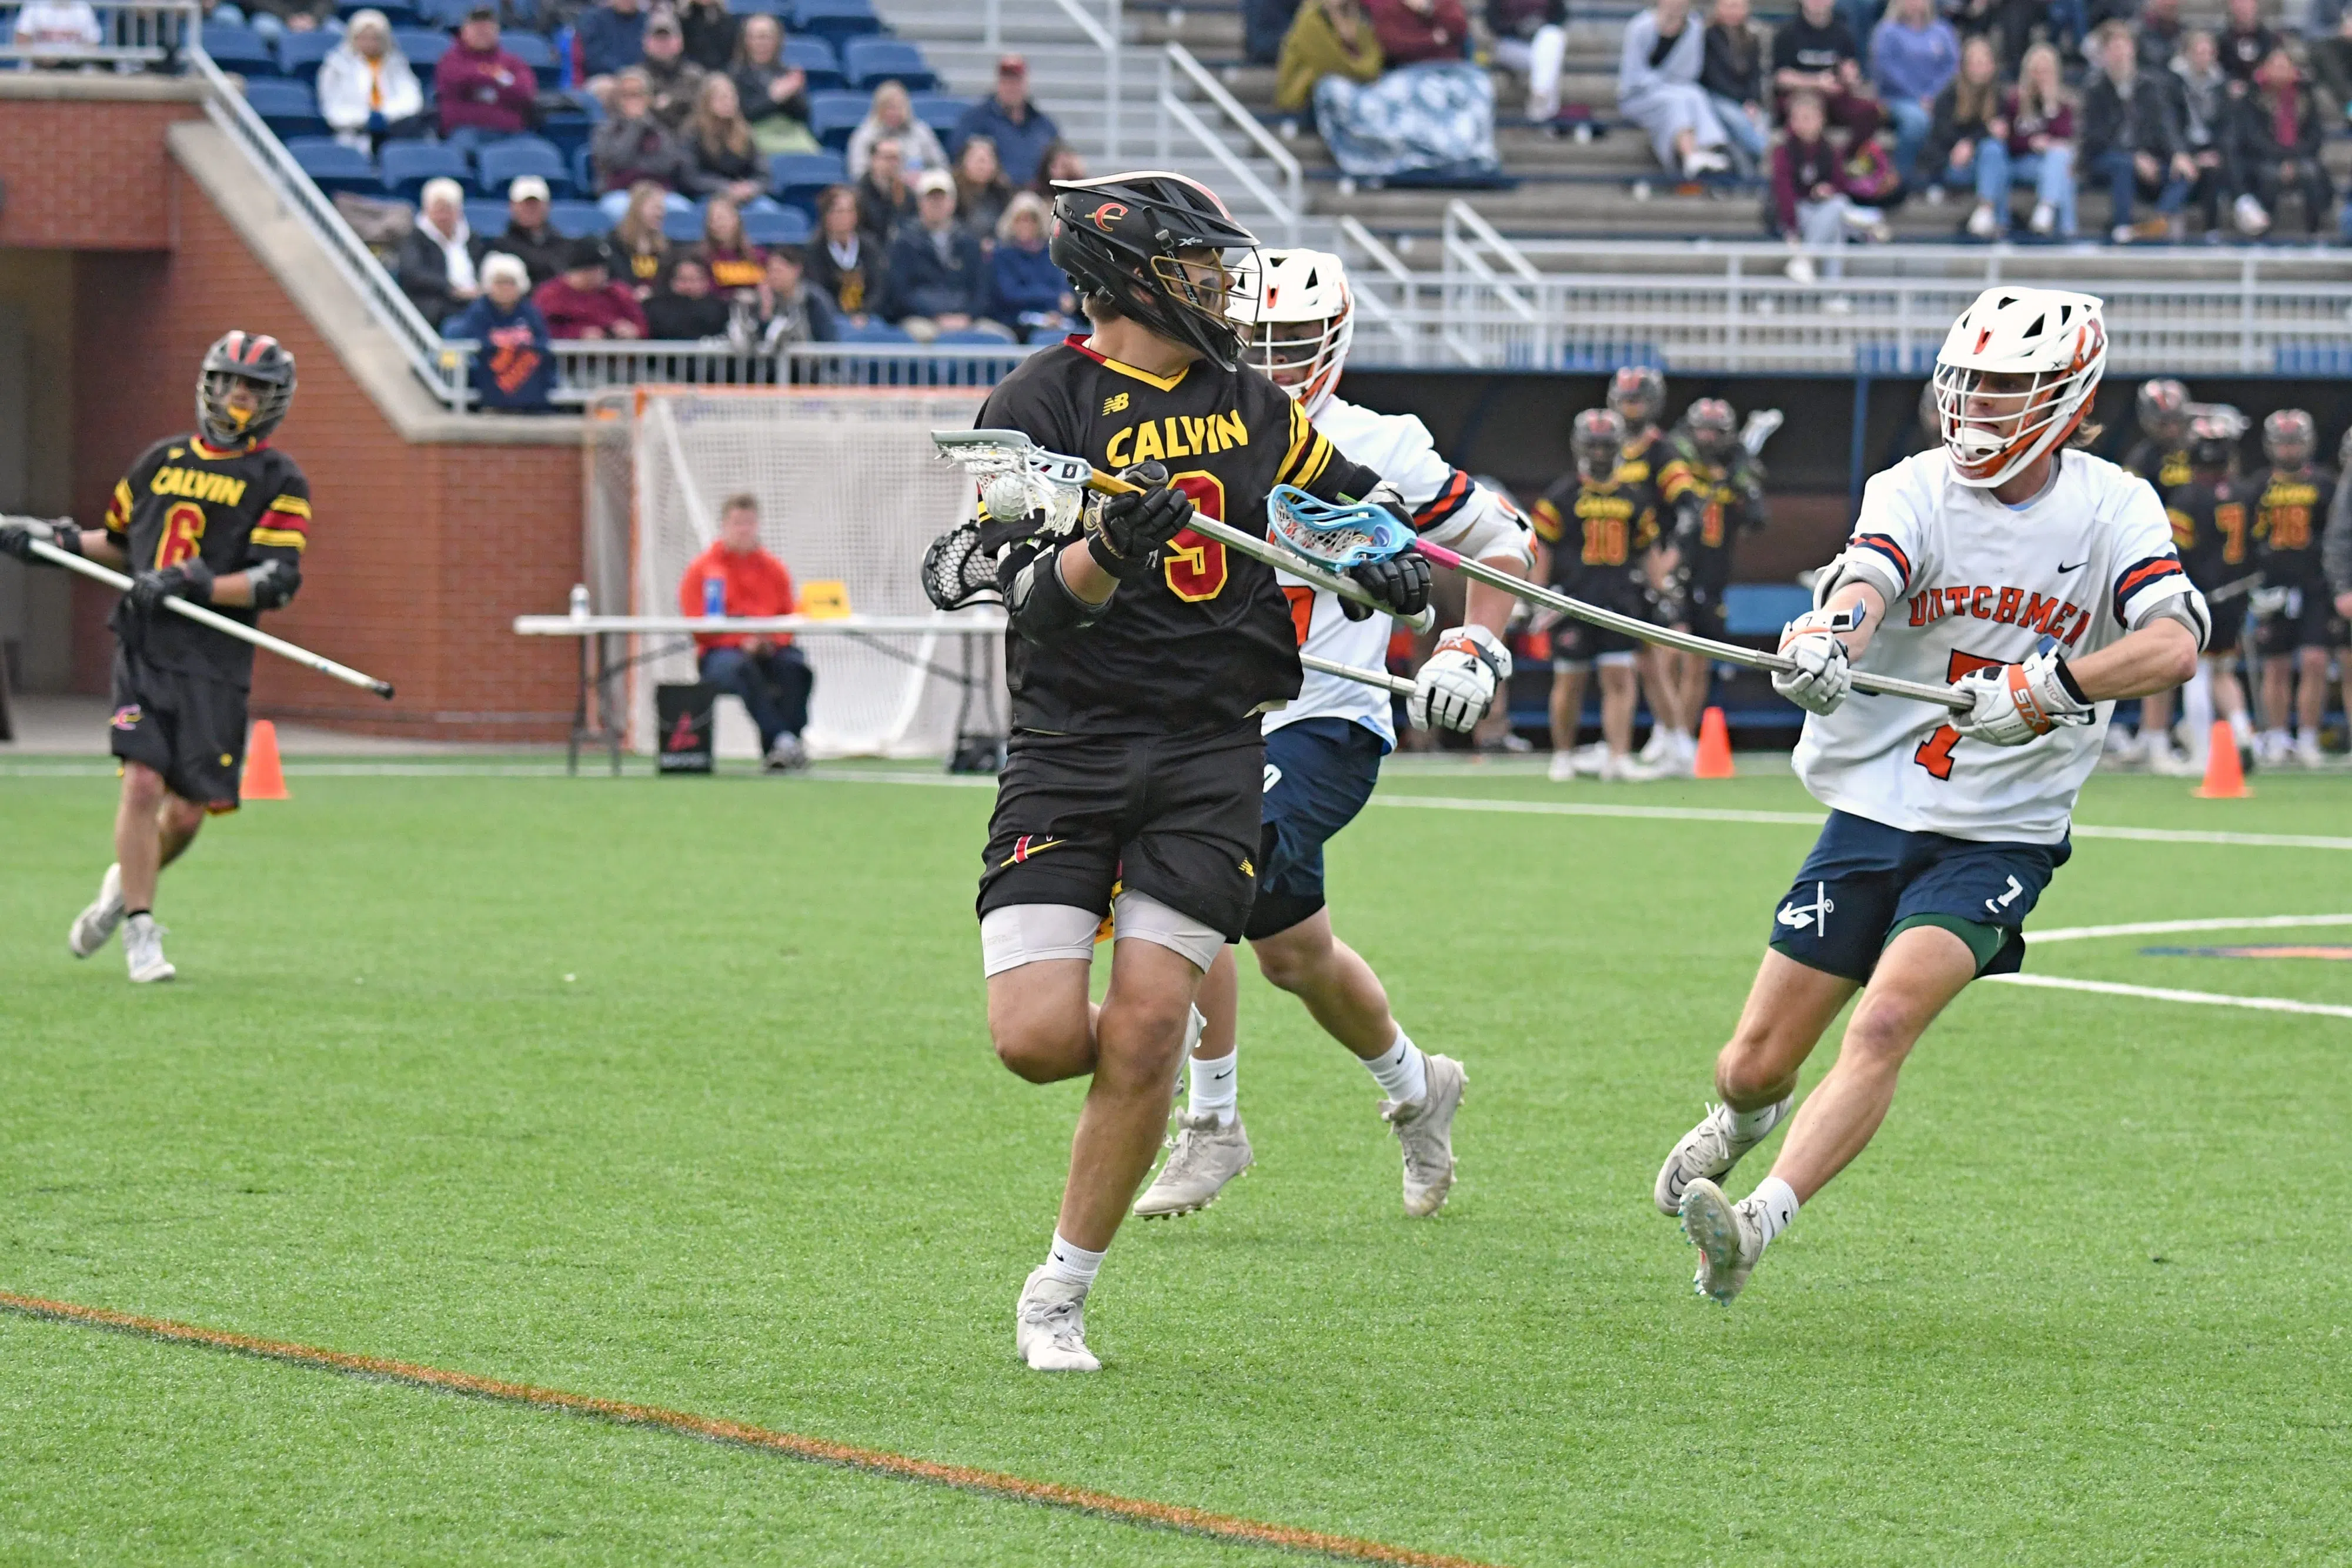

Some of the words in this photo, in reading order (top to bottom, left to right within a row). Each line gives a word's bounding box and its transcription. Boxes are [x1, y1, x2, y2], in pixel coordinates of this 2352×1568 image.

[1102, 392, 1129, 416] NB
[1106, 409, 1248, 468] CALVIN
[151, 466, 248, 507] CALVIN
[154, 501, 206, 571] 6
[1164, 470, 1228, 603] 9
[1581, 512, 1629, 566] 10
[1805, 616, 1813, 627] 7
[2013, 688, 2046, 727] STX
[1997, 874, 2023, 907] 7
